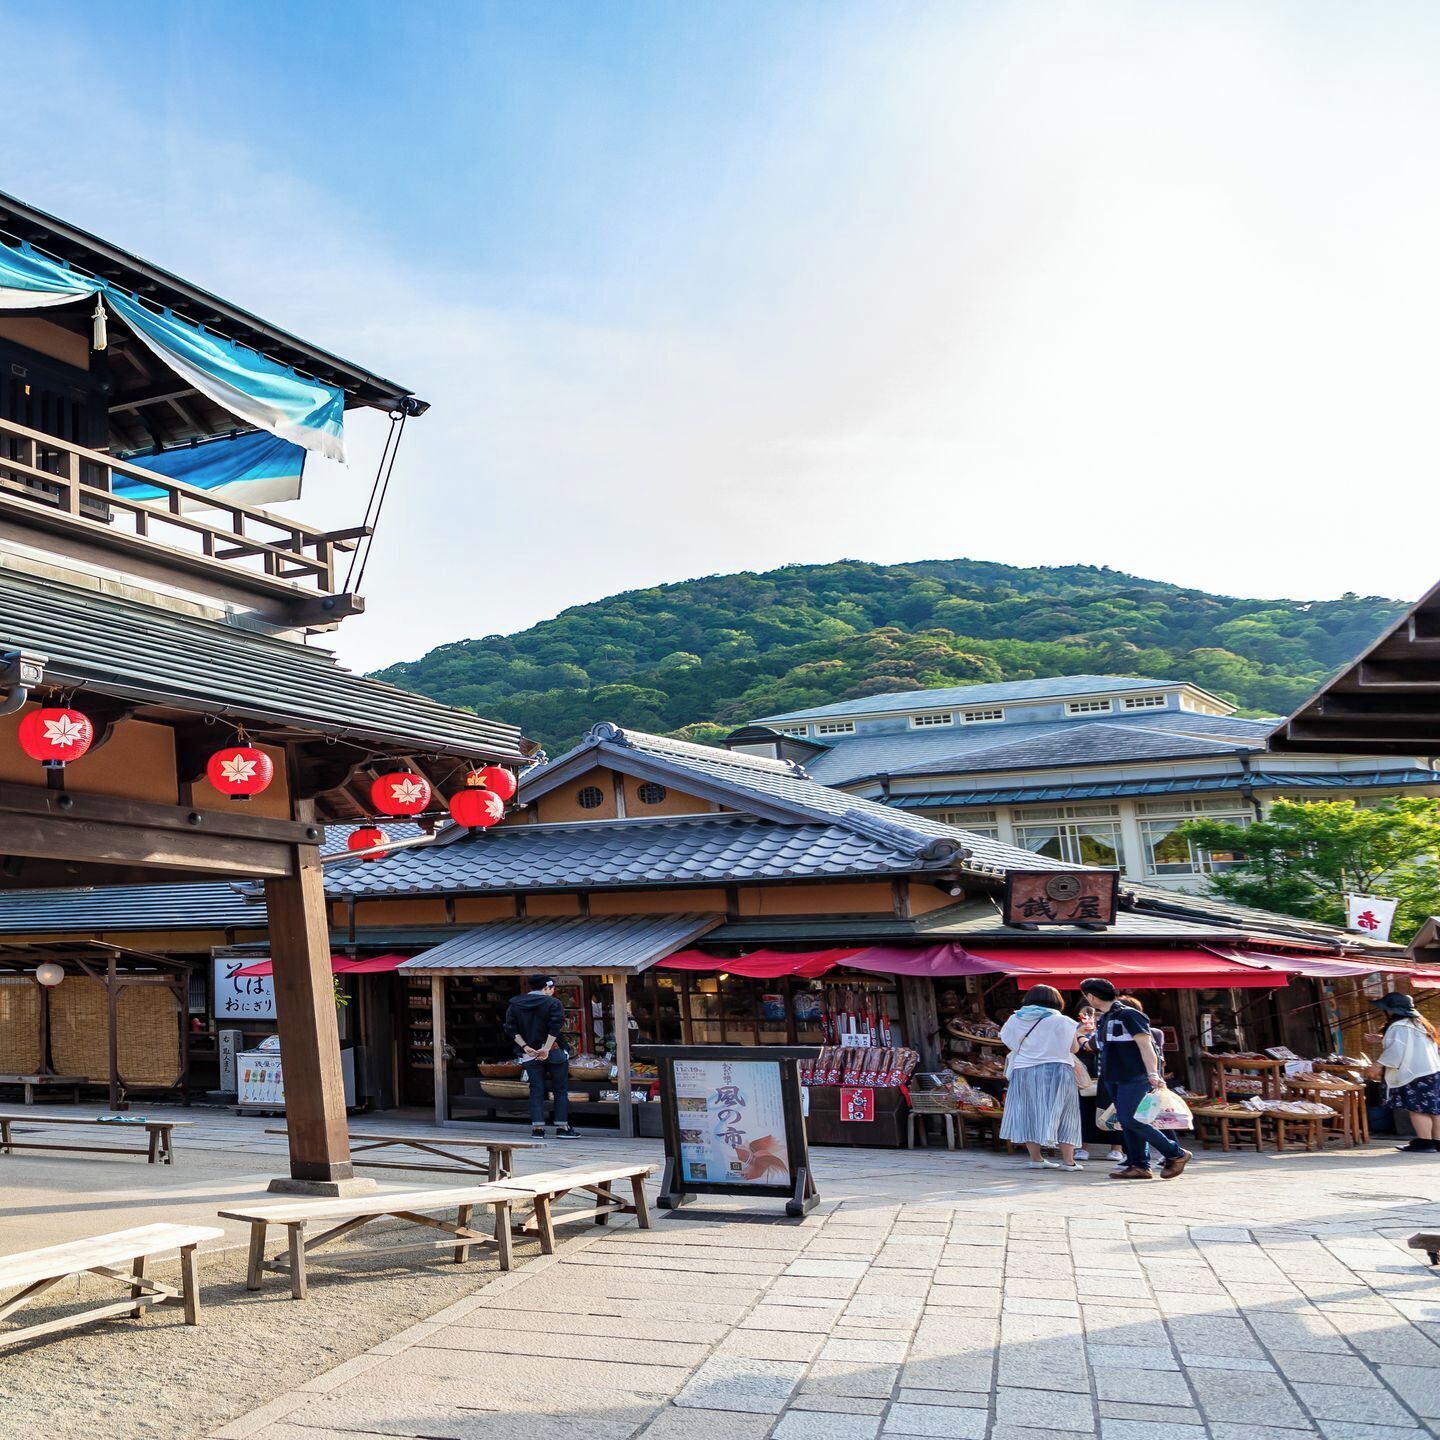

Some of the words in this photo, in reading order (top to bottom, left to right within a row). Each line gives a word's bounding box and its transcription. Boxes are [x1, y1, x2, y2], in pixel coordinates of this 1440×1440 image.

[1015, 896, 1102, 920] 銭屋
[225, 997, 272, 1013] おにぎり
[714, 1085, 746, 1149] 風の市
